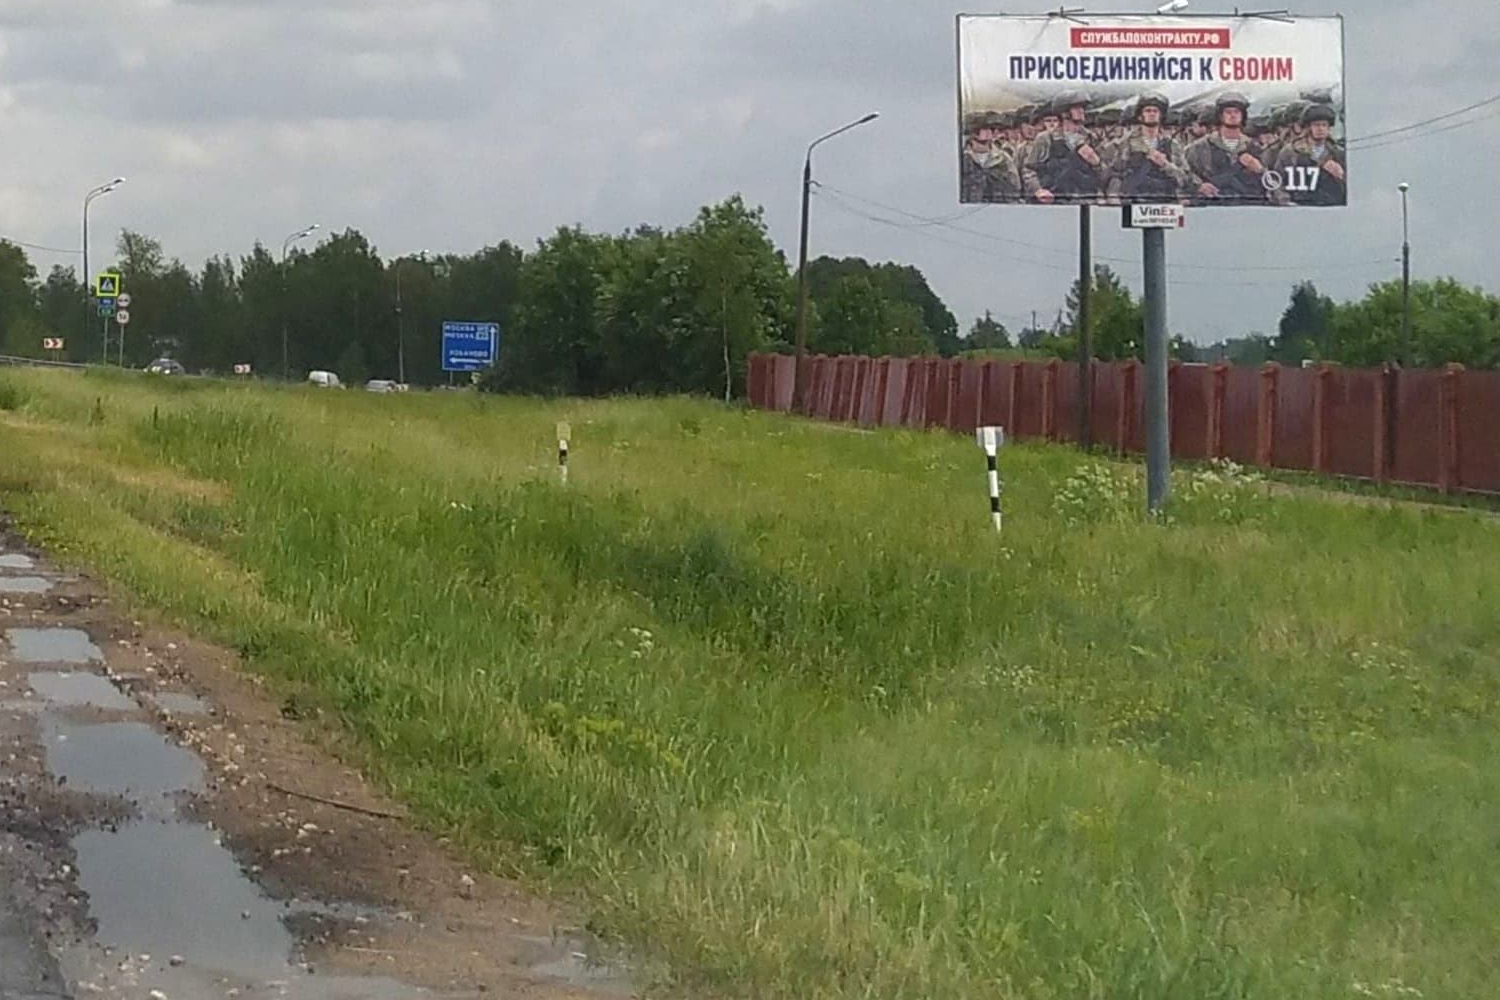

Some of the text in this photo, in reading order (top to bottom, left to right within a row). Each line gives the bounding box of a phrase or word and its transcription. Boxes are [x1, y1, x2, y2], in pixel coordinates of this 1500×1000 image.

[1080, 31, 1221, 45] СЛУЖБАПОКОНТРАКТУ.РФ
[1009, 52, 1293, 82] ПРИСОЕДИНЯЙСЯ К СВОИМ
[1284, 166, 1320, 191] 117
